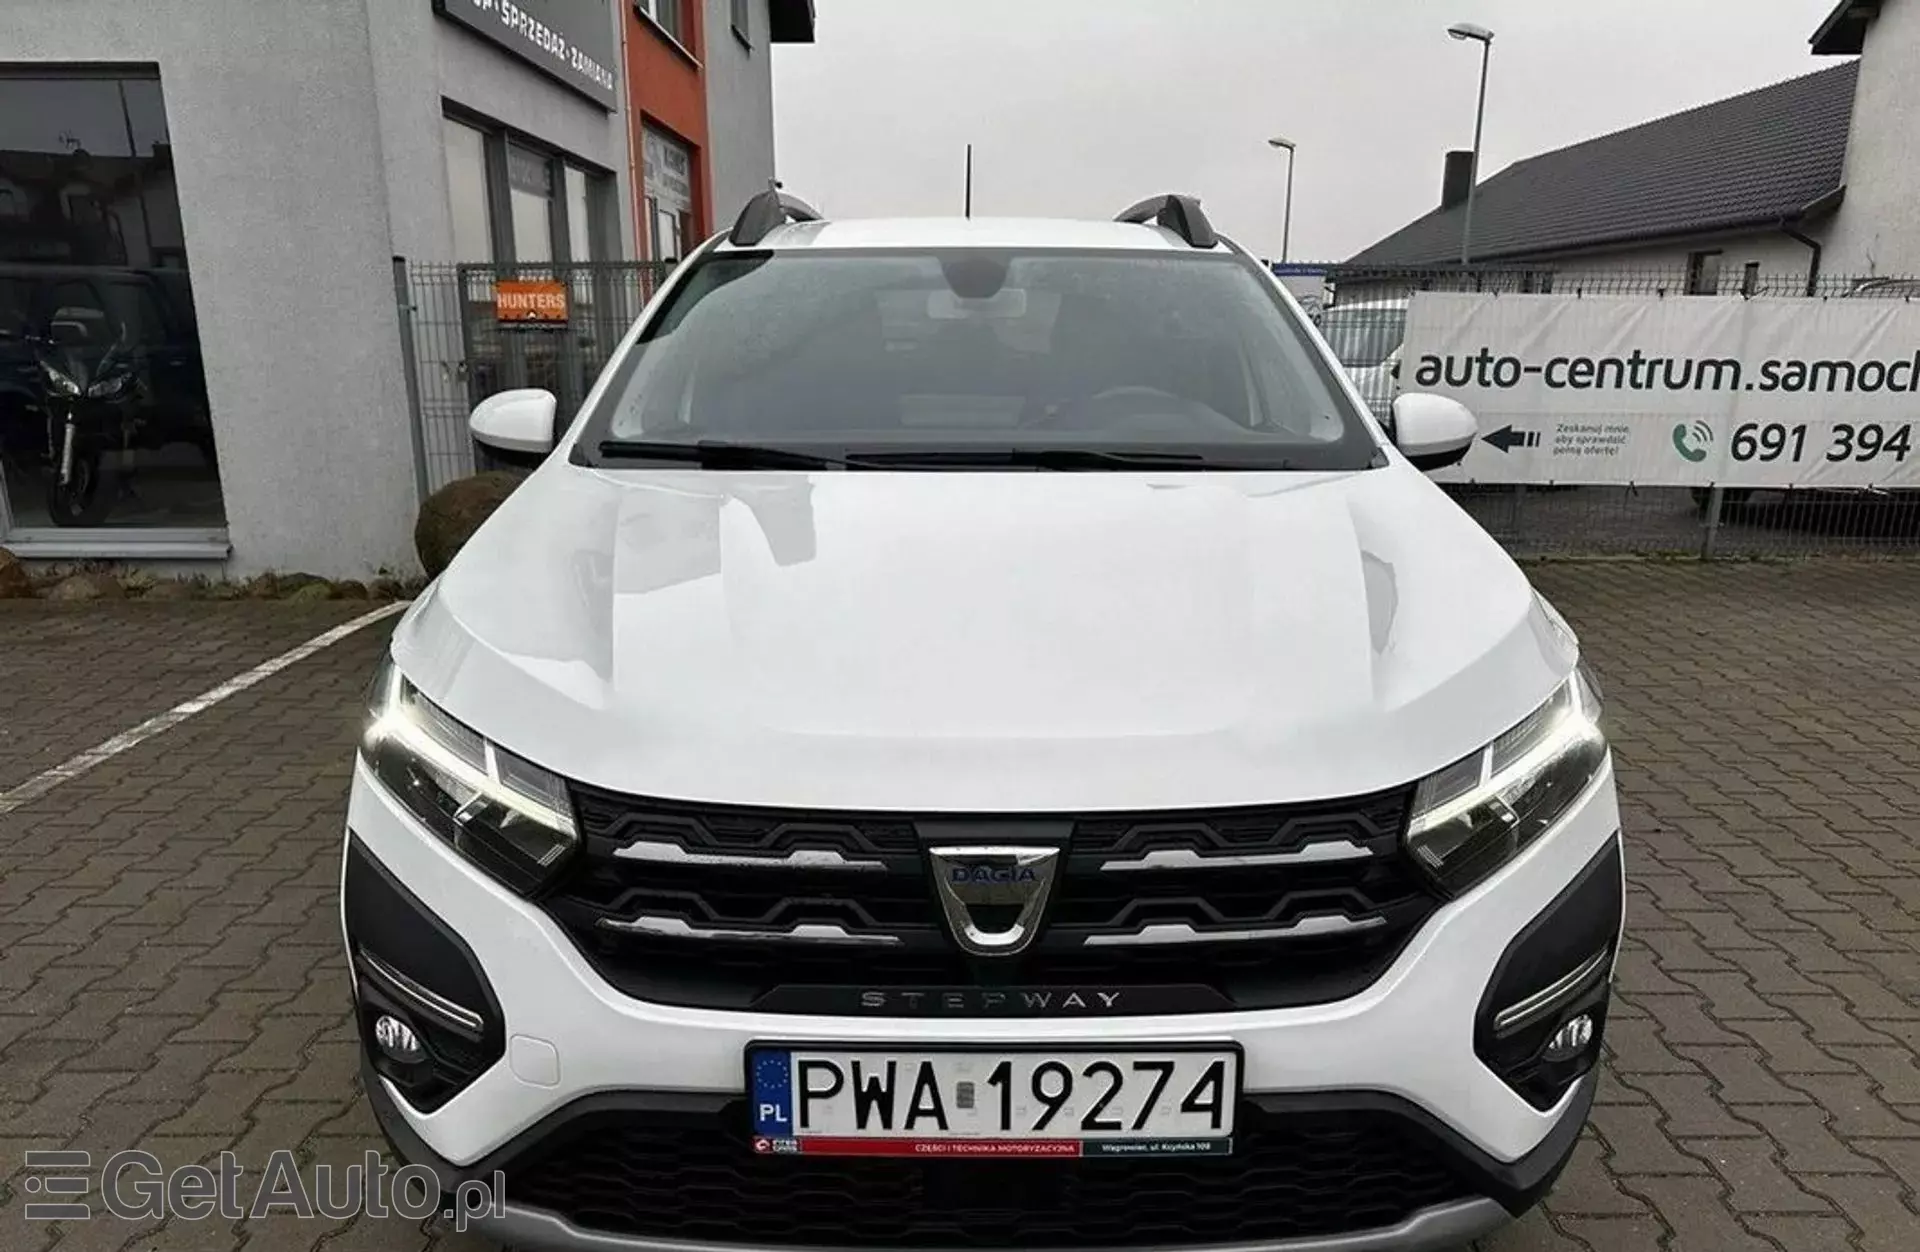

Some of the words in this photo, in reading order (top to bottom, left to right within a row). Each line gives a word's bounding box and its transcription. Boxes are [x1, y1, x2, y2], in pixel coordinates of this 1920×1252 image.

[497, 293, 566, 309] HUNTERS
[1731, 422, 1807, 462] 691
[1826, 423, 1911, 462] 394
[951, 867, 1036, 883] DACIA
[860, 991, 1120, 1009] STEPWAY
[799, 1060, 949, 1131] PWA
[987, 1060, 1226, 1131] 19274
[759, 1103, 788, 1122] PL
[953, 1143, 996, 1153] TECHNIKA
